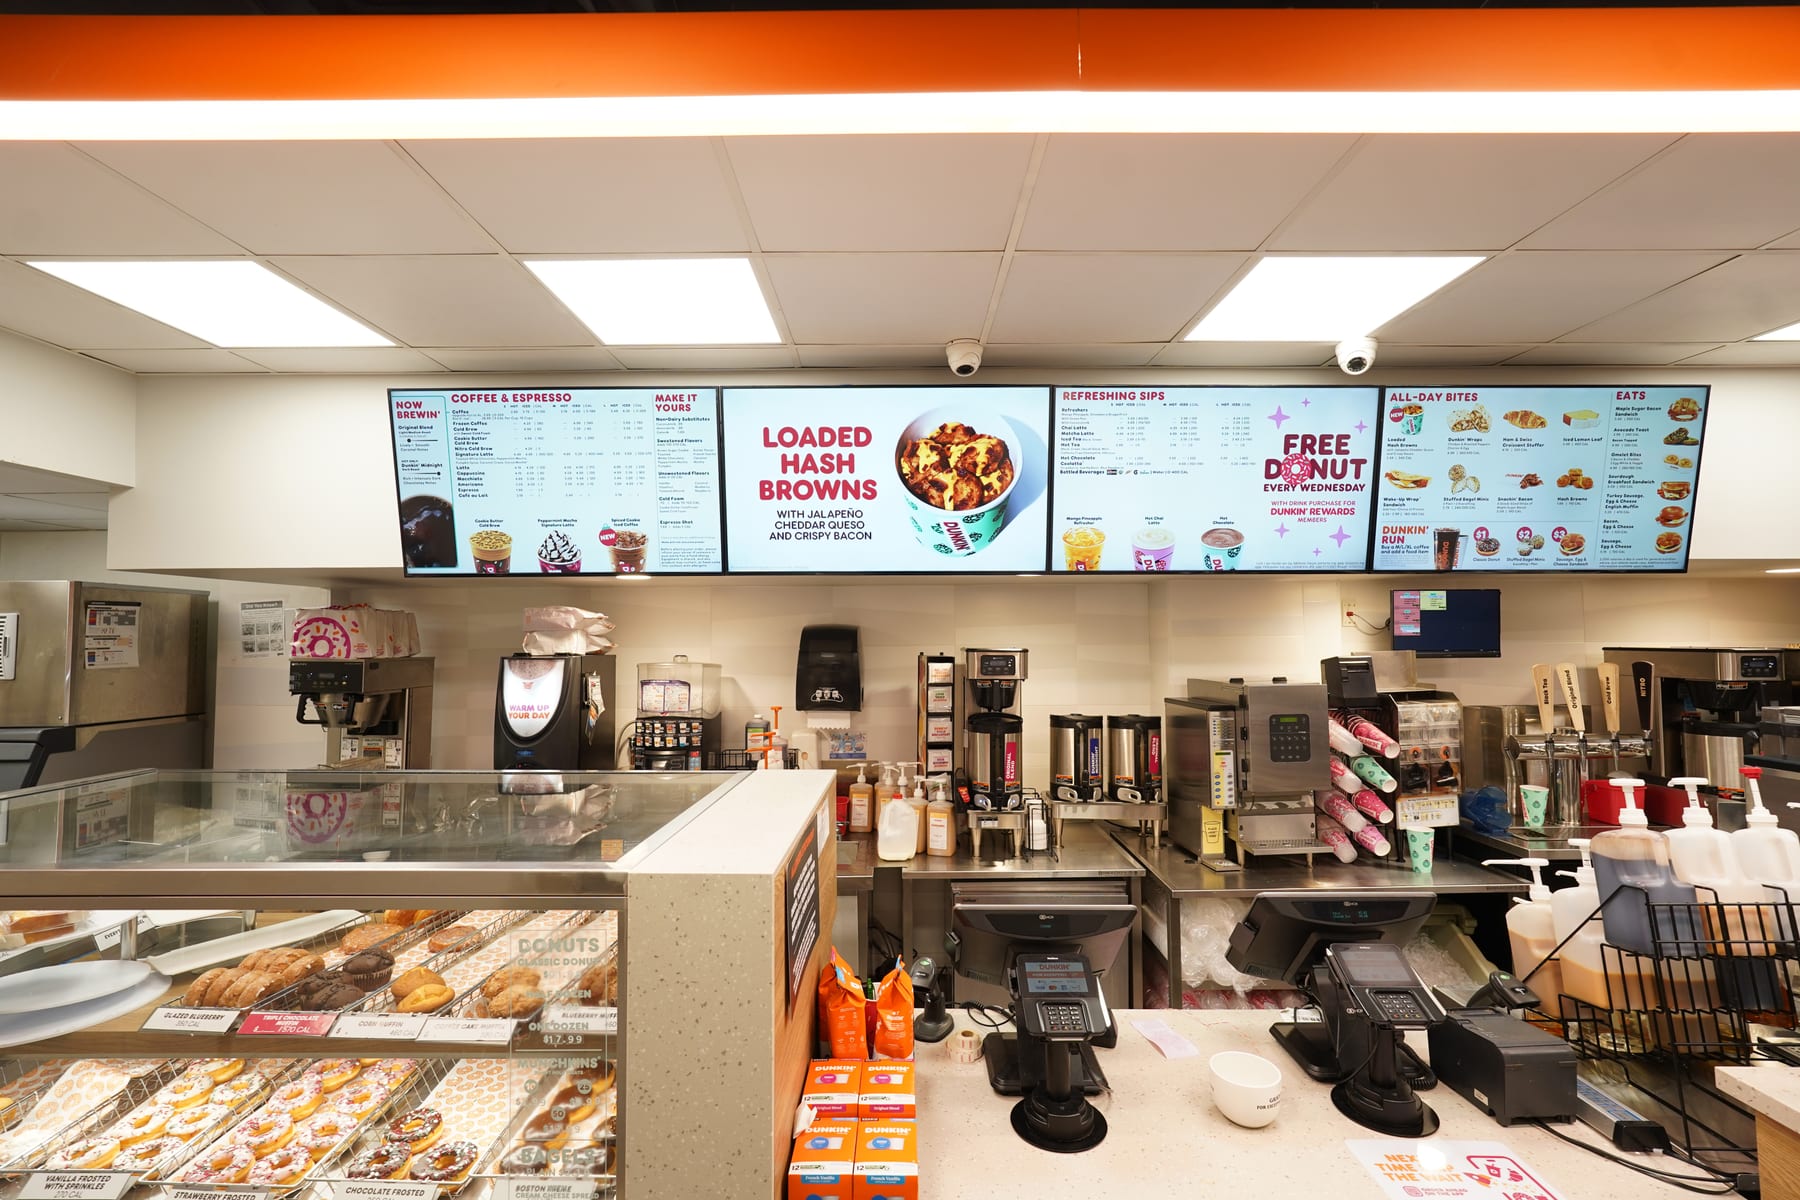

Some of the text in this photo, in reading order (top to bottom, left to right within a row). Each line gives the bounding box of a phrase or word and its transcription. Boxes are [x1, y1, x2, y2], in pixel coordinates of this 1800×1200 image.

[451, 394, 571, 403] COFFEE & ESPRESSO
[656, 394, 697, 402] MAKE IT
[1063, 392, 1165, 400] REFRESHING SIPS
[1390, 393, 1478, 402] ALL-DAY BITES
[1616, 391, 1646, 400] EATS
[656, 404, 691, 412] YOURS
[397, 411, 440, 419] BREWIN'
[763, 427, 872, 447] LOADED
[1283, 434, 1351, 455] FREE
[781, 453, 855, 474] HASH
[759, 479, 877, 501] BROWNS
[1264, 484, 1296, 492] EVERY
[777, 508, 863, 519] WITH JALAPEÑO
[775, 521, 865, 530] CHEDDAR QUESO
[1383, 526, 1429, 534] DUNKIN'
[769, 531, 872, 540] AND CRISPY BACON
[1476, 532, 1487, 540] $1
[1518, 531, 1531, 539] $2
[1553, 531, 1566, 539] $3
[1382, 536, 1405, 544] RUN
[1564, 670, 1577, 708] Original Blend
[519, 939, 599, 953] DONUTS
[518, 958, 560, 966] CLASSIC
[543, 1035, 582, 1044] $17.99
[521, 1148, 595, 1163] BAGELS
[1384, 1154, 1418, 1162] NEX
[1374, 1163, 1415, 1172] TIME
[1384, 1173, 1464, 1182] THE WAIT
[65, 1182, 106, 1190] SPRINKLES
[174, 1192, 220, 1200] STRAWBERRY
[345, 1187, 425, 1197] CHOCOLATE FROSTED
